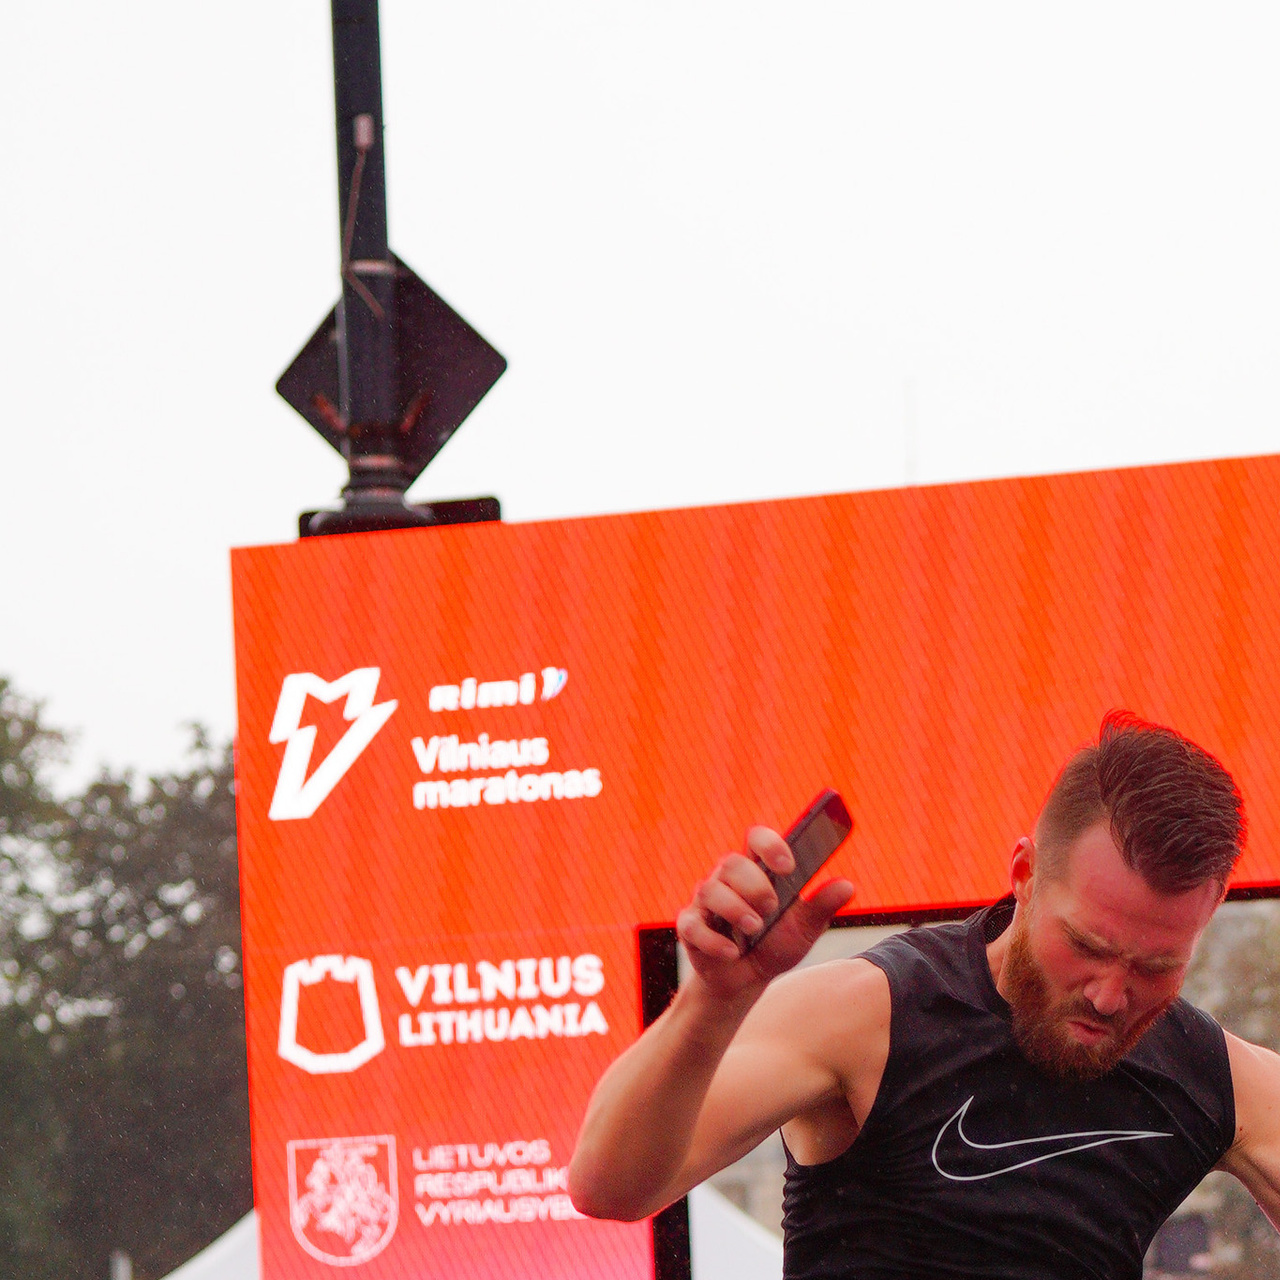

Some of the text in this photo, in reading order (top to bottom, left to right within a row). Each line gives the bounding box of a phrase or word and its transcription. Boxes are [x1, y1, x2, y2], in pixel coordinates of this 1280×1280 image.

[429, 672, 537, 712] rimi
[411, 733, 549, 774] Vilniaus
[413, 768, 603, 810] maratonas
[395, 953, 605, 1007] VILNIUS
[398, 1002, 609, 1047] LITHUANIA
[412, 1138, 550, 1171] LIETUVOS
[414, 1166, 570, 1198] RESPUBLIK
[415, 1194, 588, 1227] VYRIAUSYB
